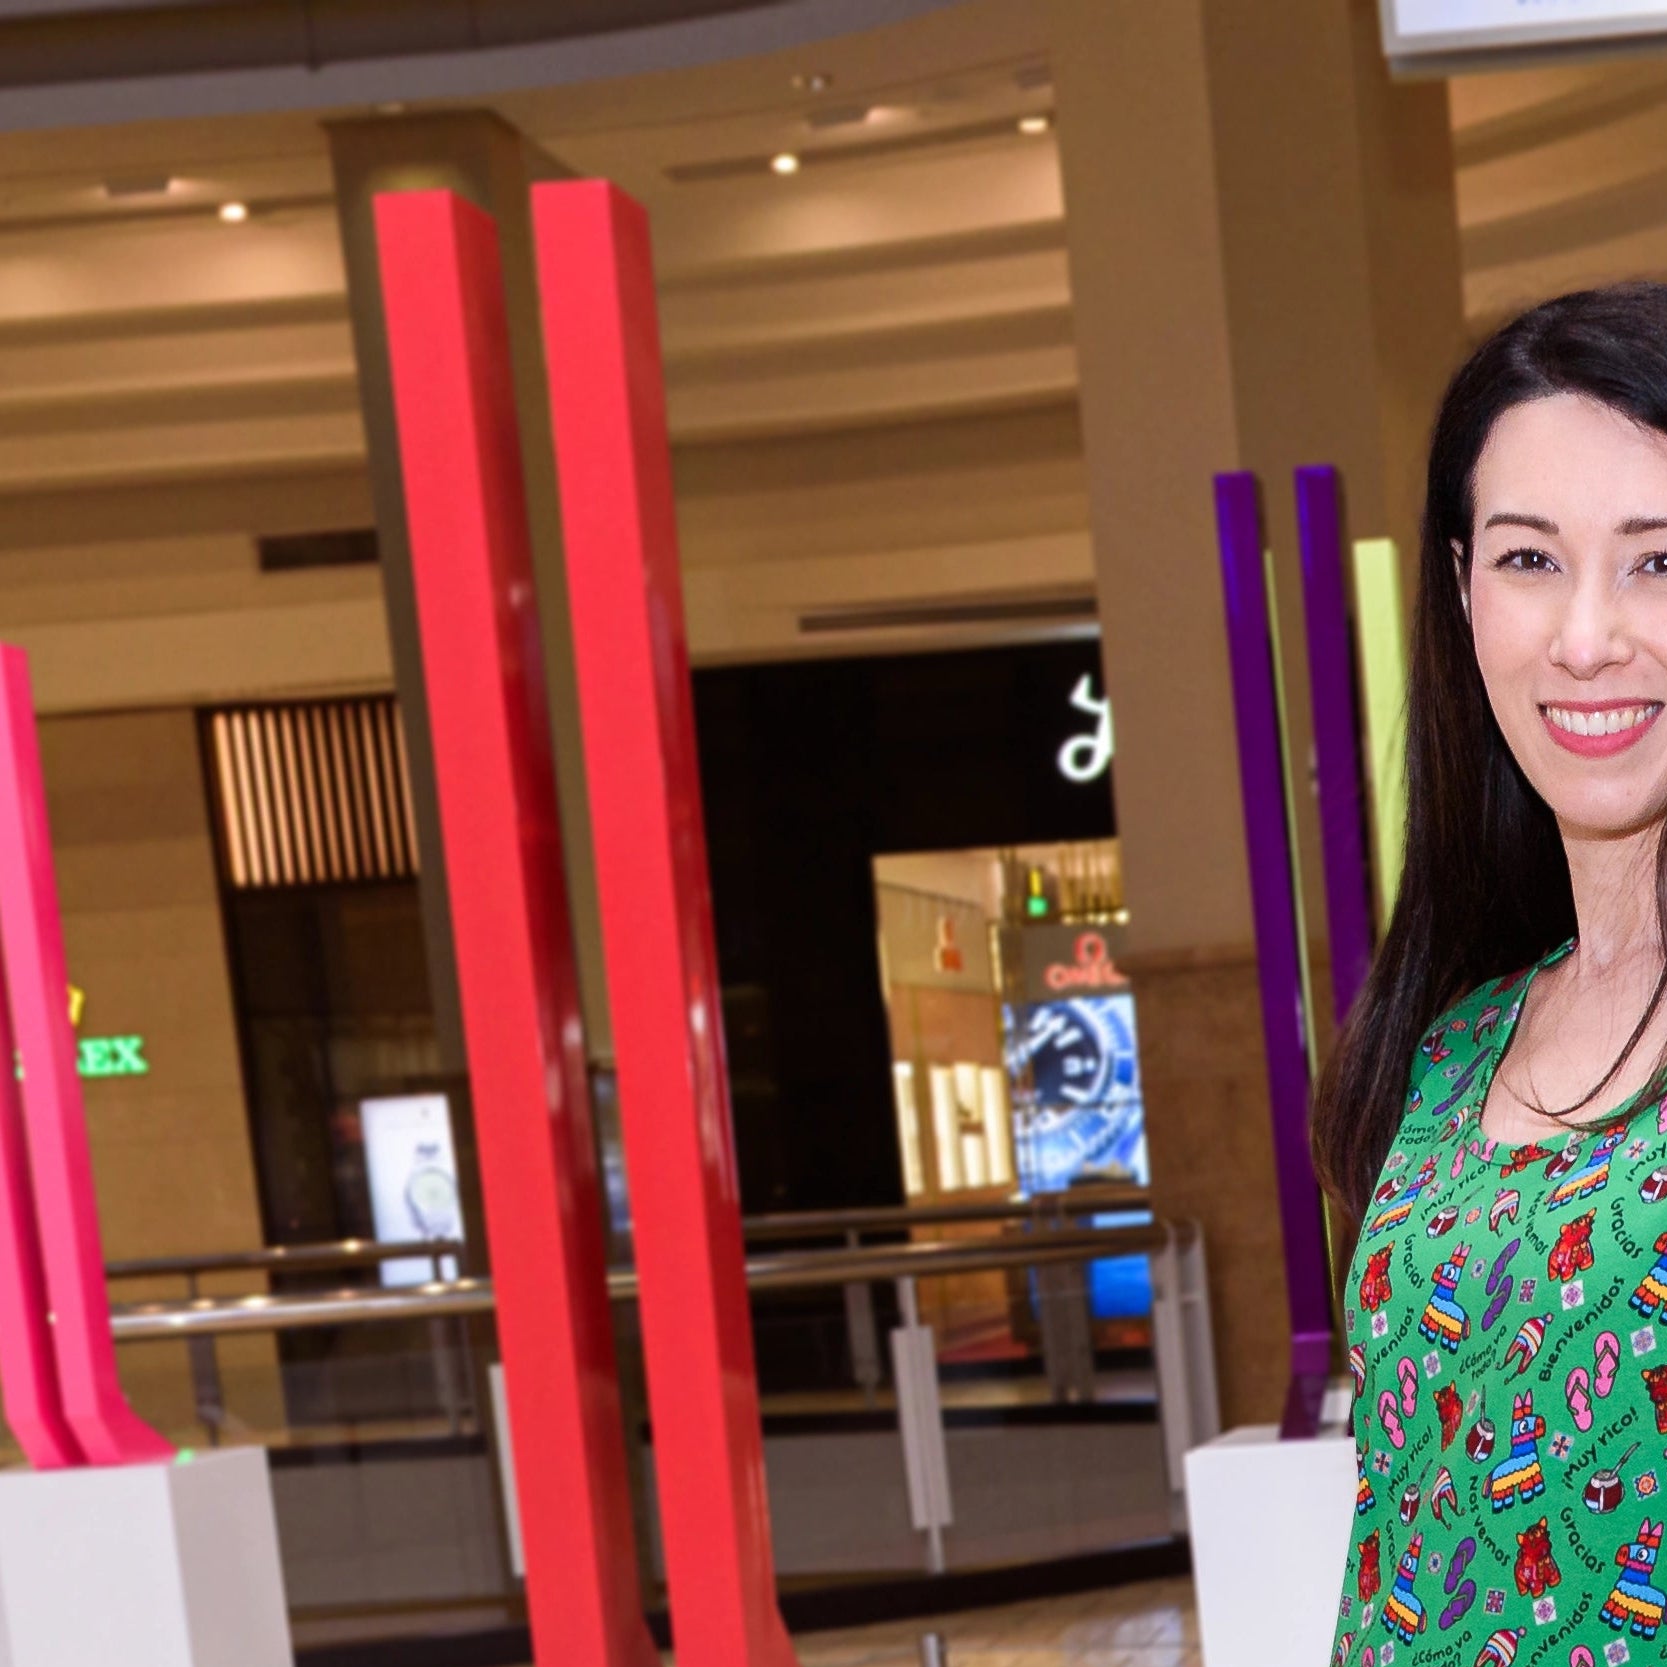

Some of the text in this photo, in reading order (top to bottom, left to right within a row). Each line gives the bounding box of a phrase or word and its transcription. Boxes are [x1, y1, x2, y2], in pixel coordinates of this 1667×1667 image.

[1421, 1162, 1492, 1220] ¡Muy rico!
[1625, 1142, 1667, 1182] ¡Muy
[1610, 1197, 1643, 1260] Gracias
[1404, 1233, 1425, 1289] Gracias
[1539, 1275, 1625, 1382] Bienvenidos
[1562, 1407, 1638, 1490] ¡Muy rico!
[1468, 1475, 1511, 1567] Nos vemos
[1560, 1507, 1606, 1574] Gracias
[1412, 1630, 1473, 1667] ¿Cómo va
